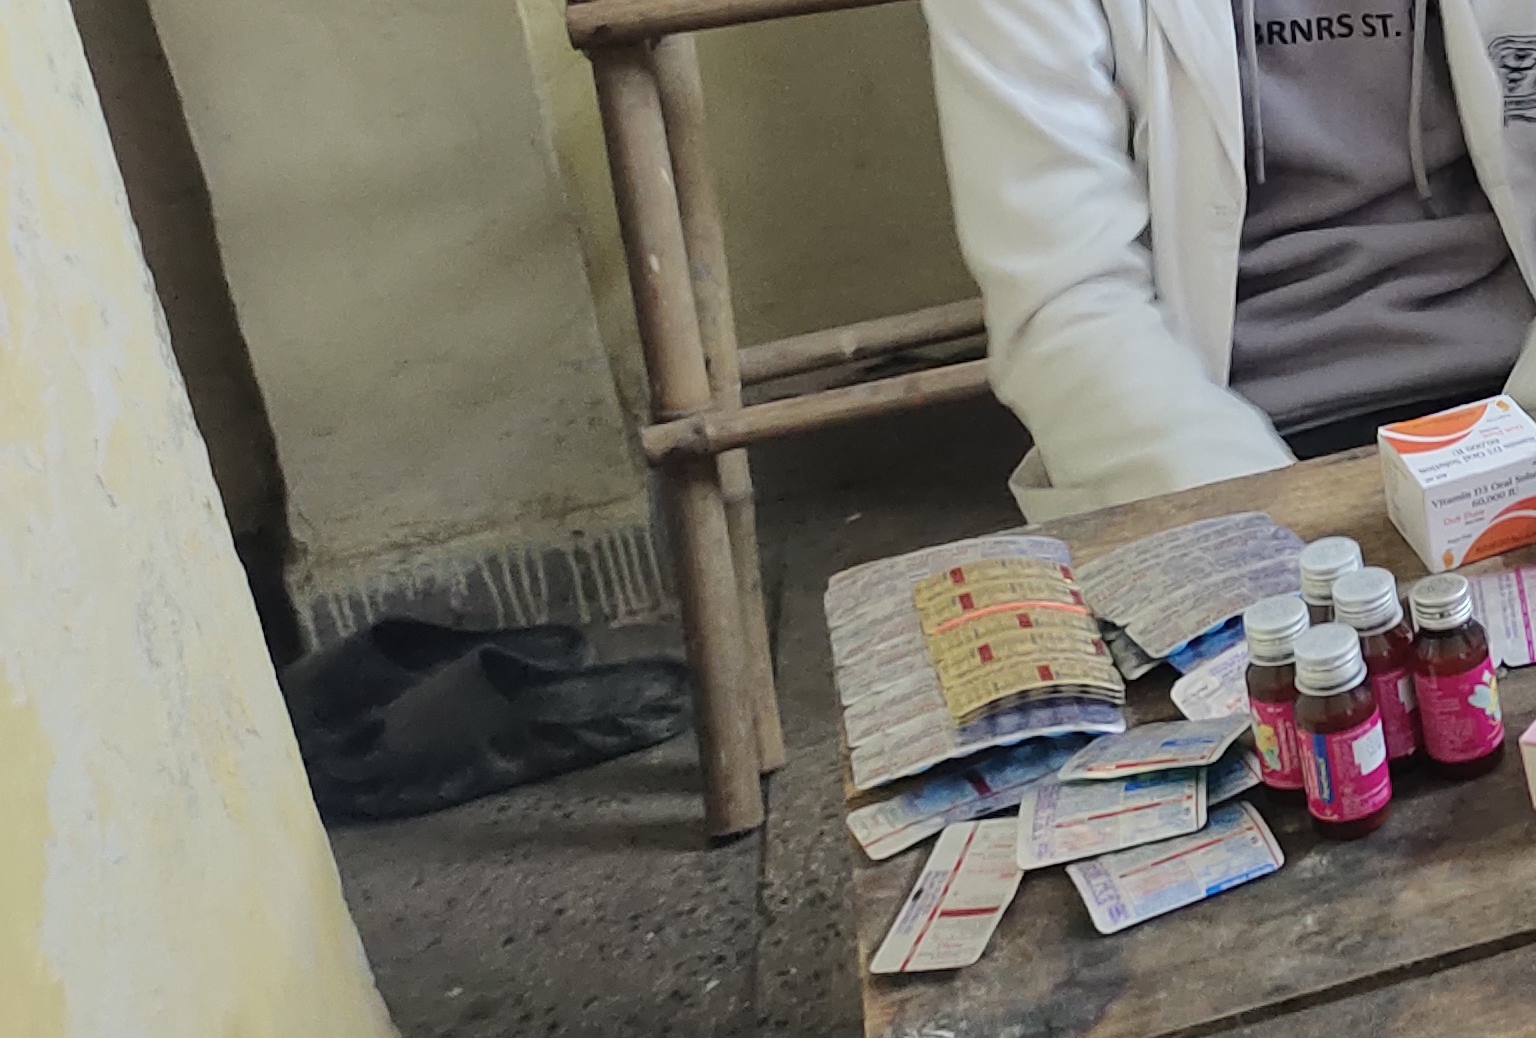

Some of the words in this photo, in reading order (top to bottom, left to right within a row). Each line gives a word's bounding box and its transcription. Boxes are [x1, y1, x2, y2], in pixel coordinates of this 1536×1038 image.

[1361, 14, 1402, 38] ST.
[1431, 491, 1471, 509] Vitamin
[1474, 485, 1489, 497] D3
[1490, 478, 1513, 493] Oral
